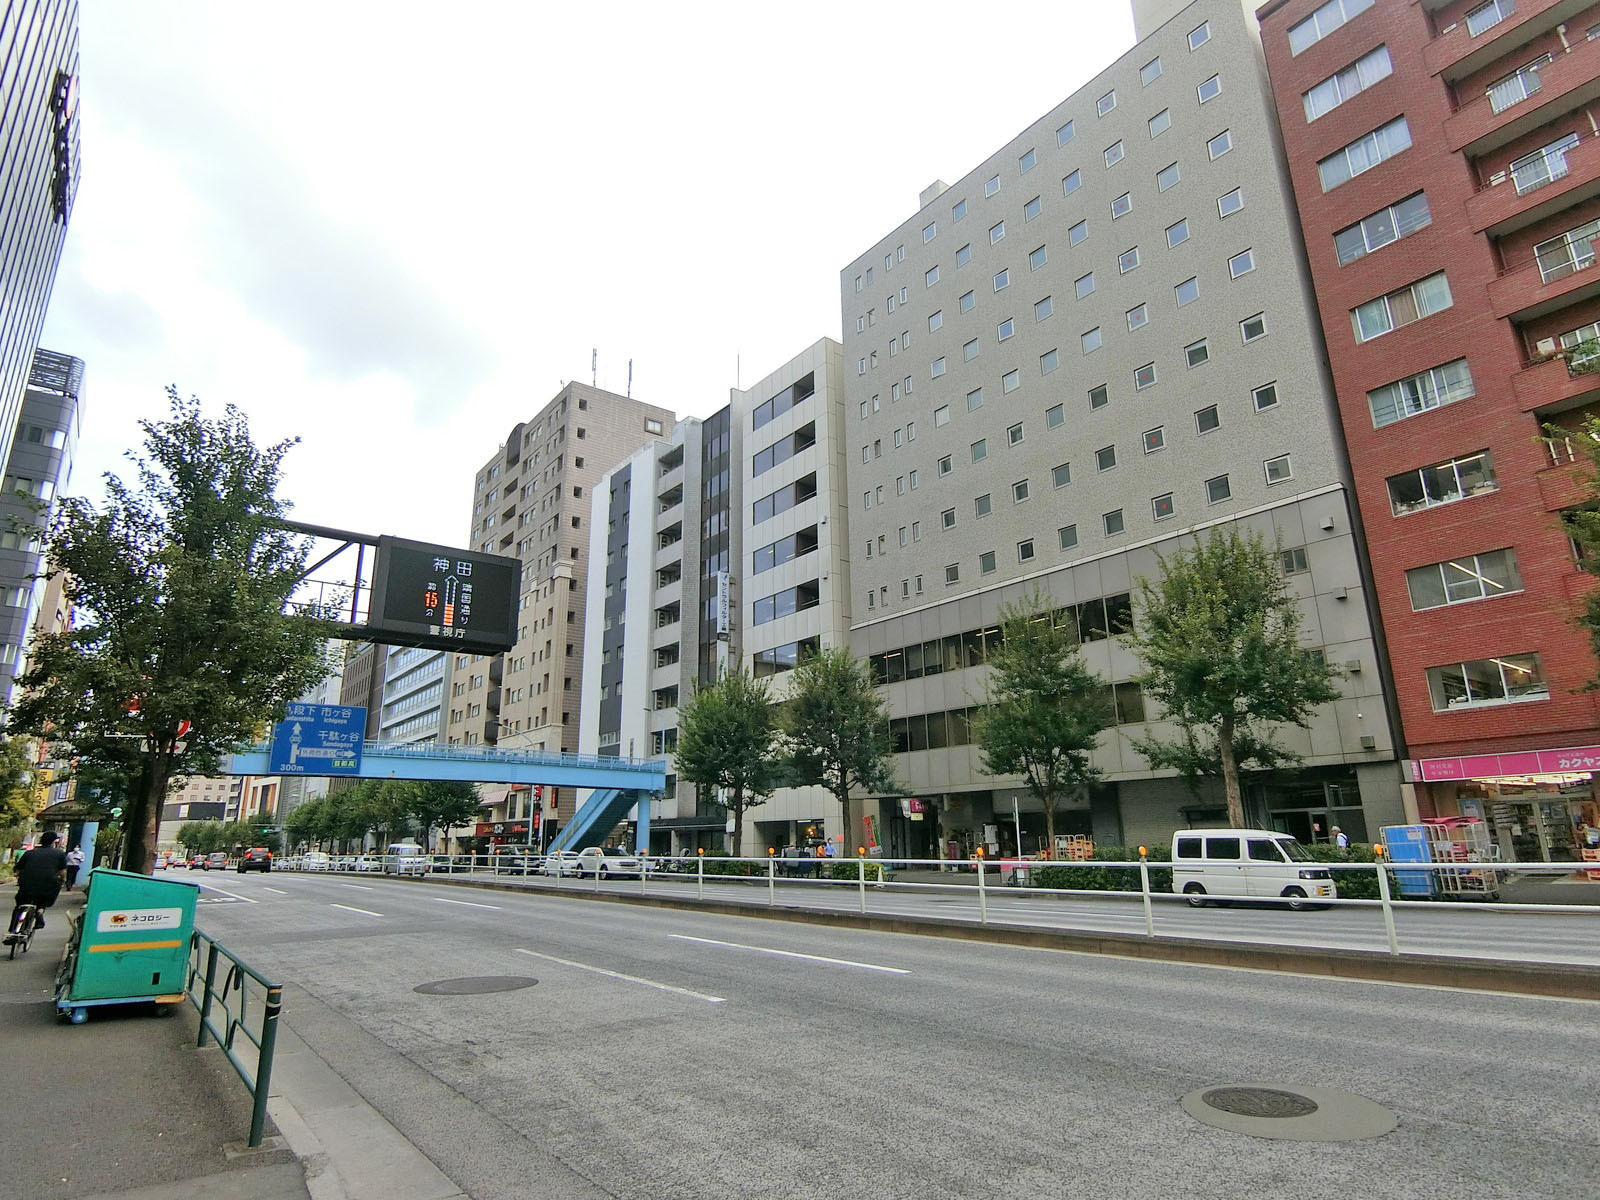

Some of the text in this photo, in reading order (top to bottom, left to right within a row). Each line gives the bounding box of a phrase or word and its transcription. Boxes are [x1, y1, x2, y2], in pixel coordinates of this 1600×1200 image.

[433, 557, 472, 576] 神田
[429, 624, 466, 639] 警視庁
[131, 914, 170, 922] ネコロジー
